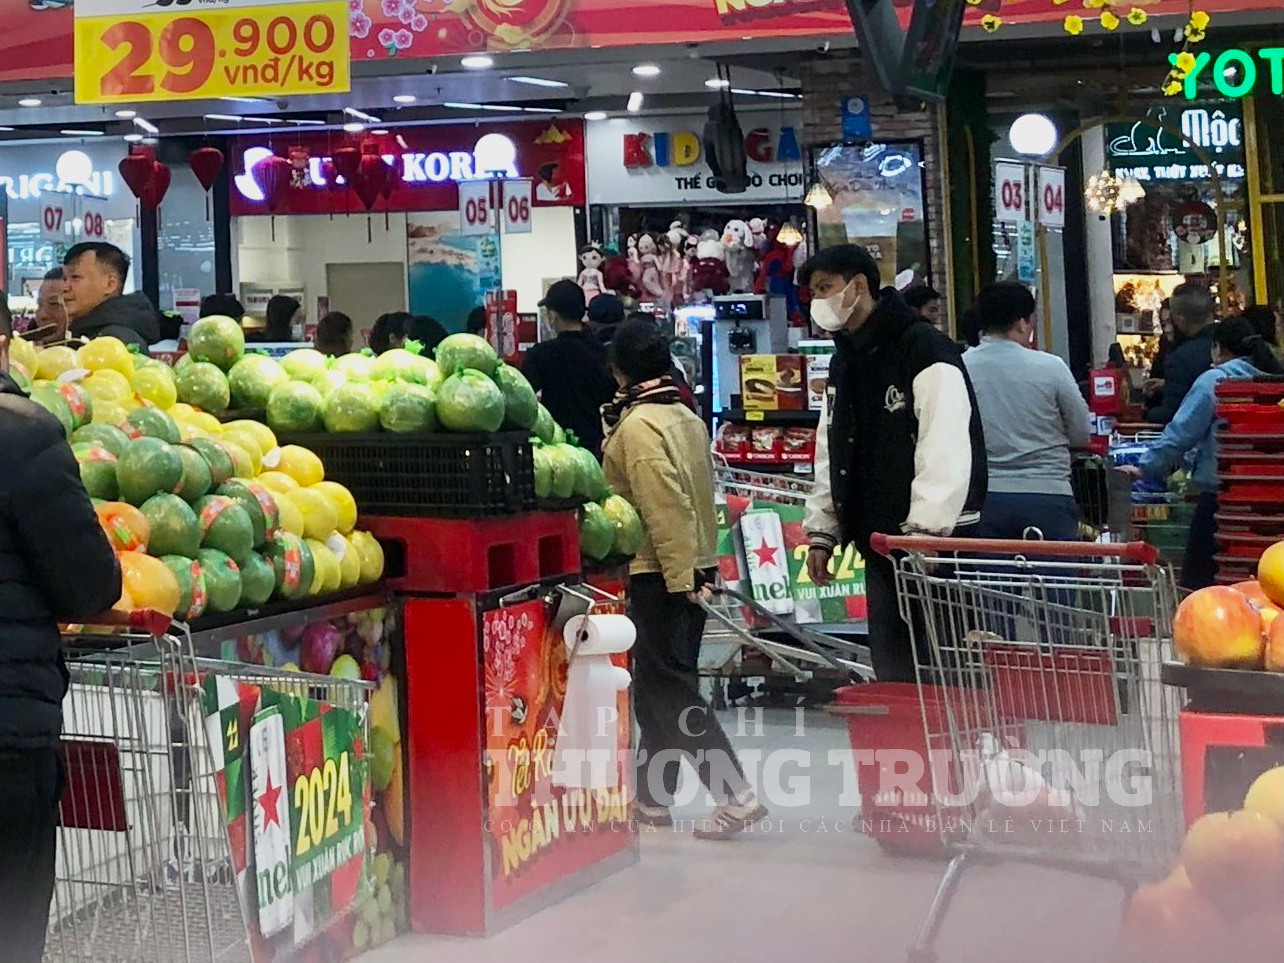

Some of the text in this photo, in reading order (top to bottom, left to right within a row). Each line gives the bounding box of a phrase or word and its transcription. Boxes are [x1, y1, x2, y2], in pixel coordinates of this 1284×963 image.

[100, 14, 335, 96] 29.900
[224, 54, 334, 88] vnđ/kg
[402, 151, 518, 182] KOR
[508, 196, 529, 222] 06
[1002, 179, 1022, 209] 03
[1045, 185, 1063, 213] 04
[44, 206, 63, 230] 07
[84, 212, 103, 236] 08
[466, 198, 487, 224] 05
[295, 751, 352, 856] 2024
[500, 797, 560, 877] NGÀN
